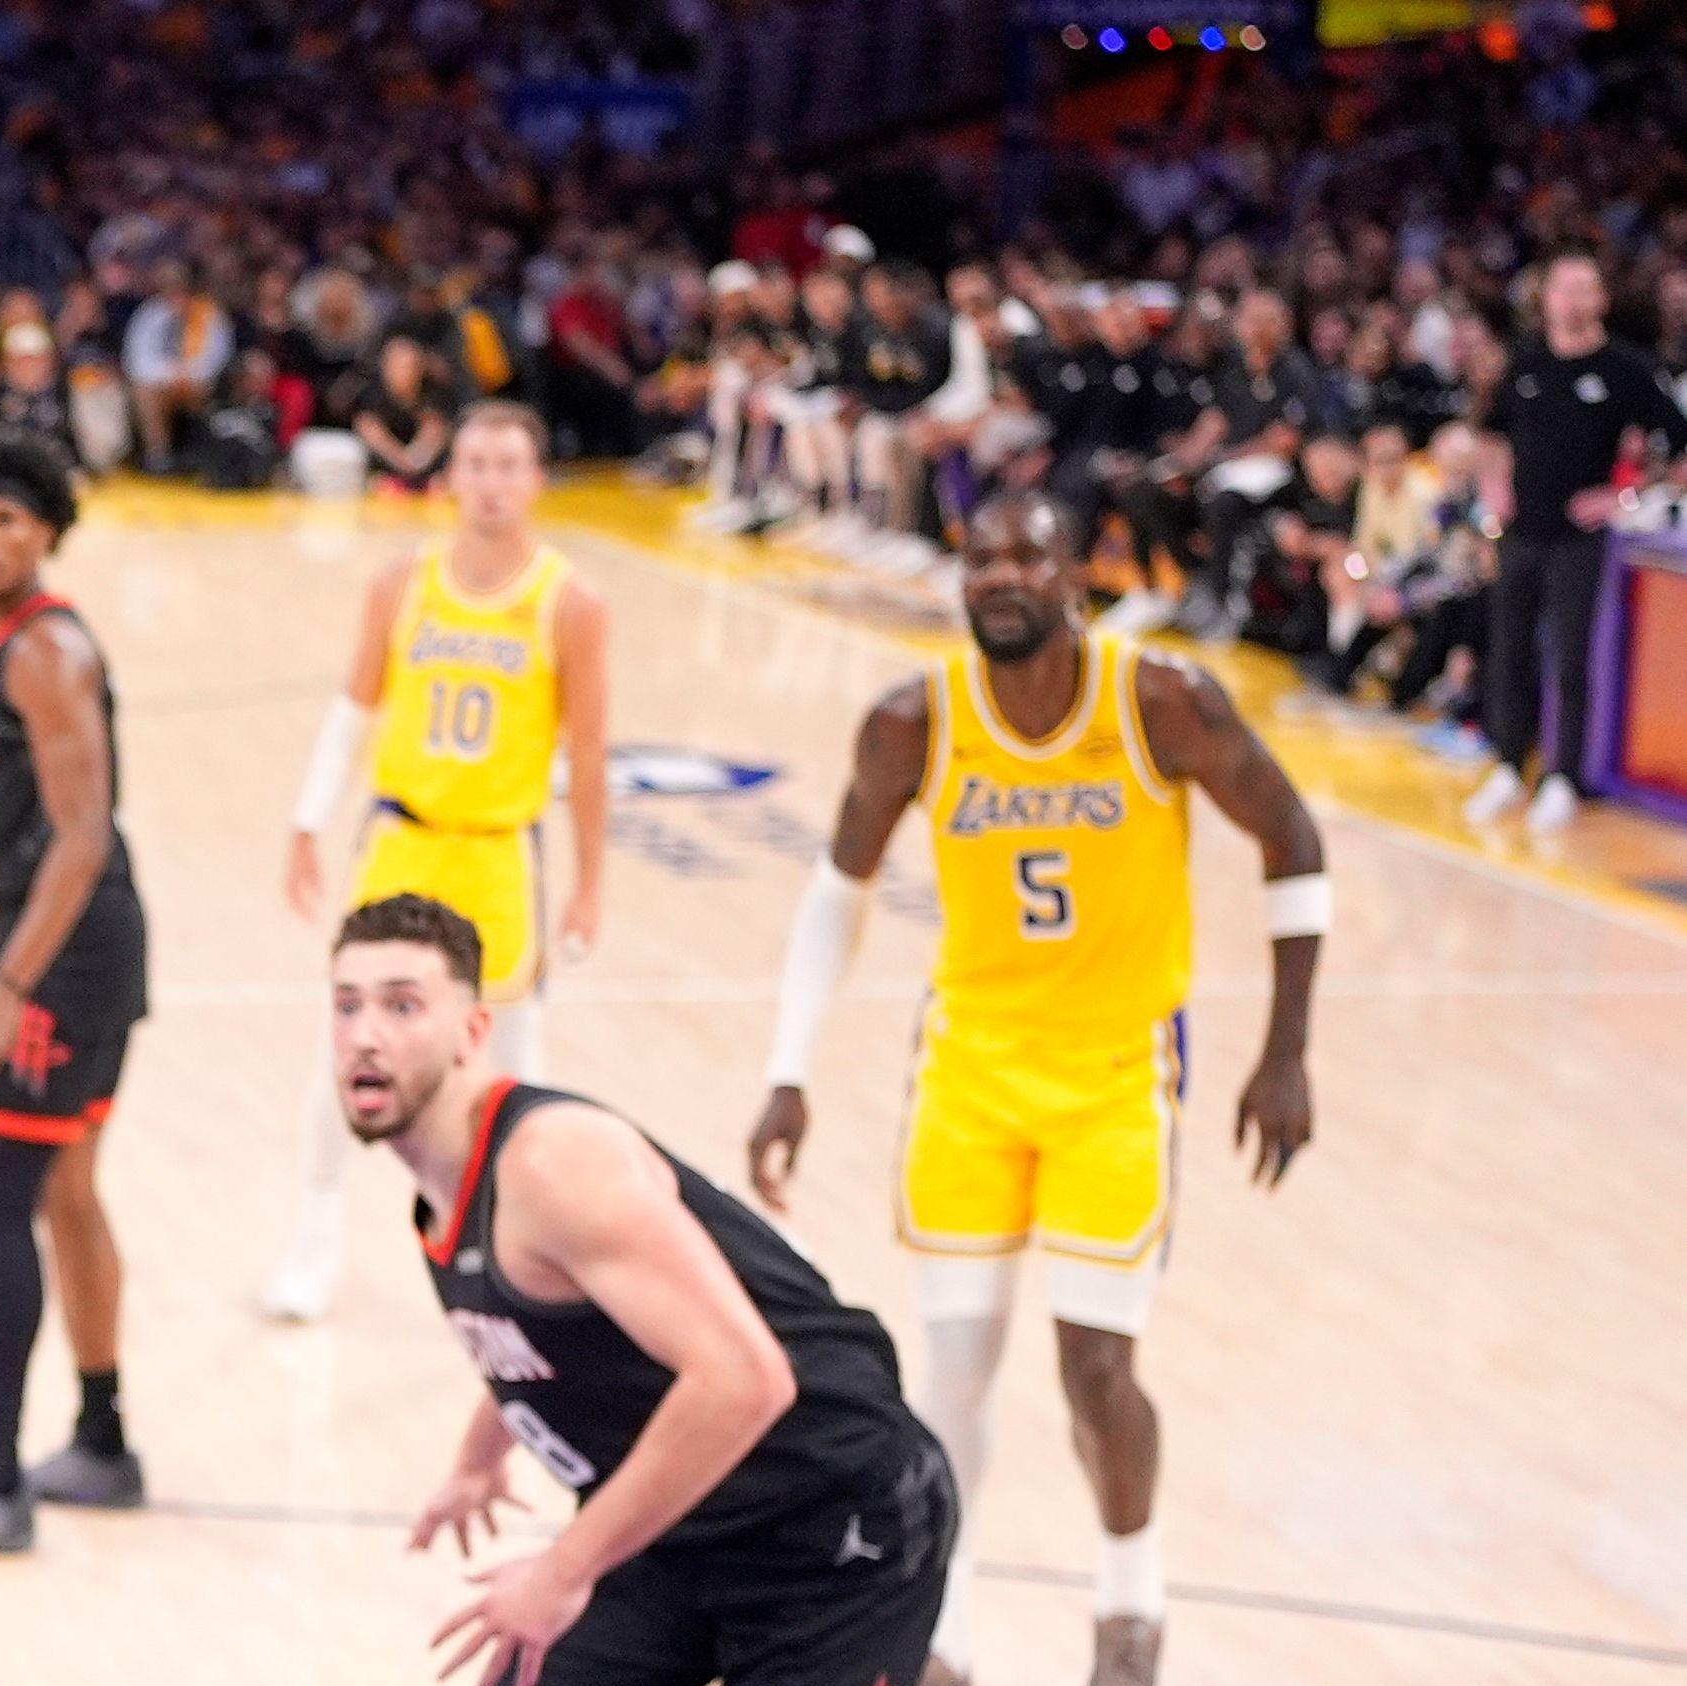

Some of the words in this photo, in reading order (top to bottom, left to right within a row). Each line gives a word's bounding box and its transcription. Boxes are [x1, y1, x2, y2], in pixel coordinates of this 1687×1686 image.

[426, 681, 494, 760] 10
[948, 775, 1125, 837] LAKERS
[1013, 850, 1077, 940] 5
